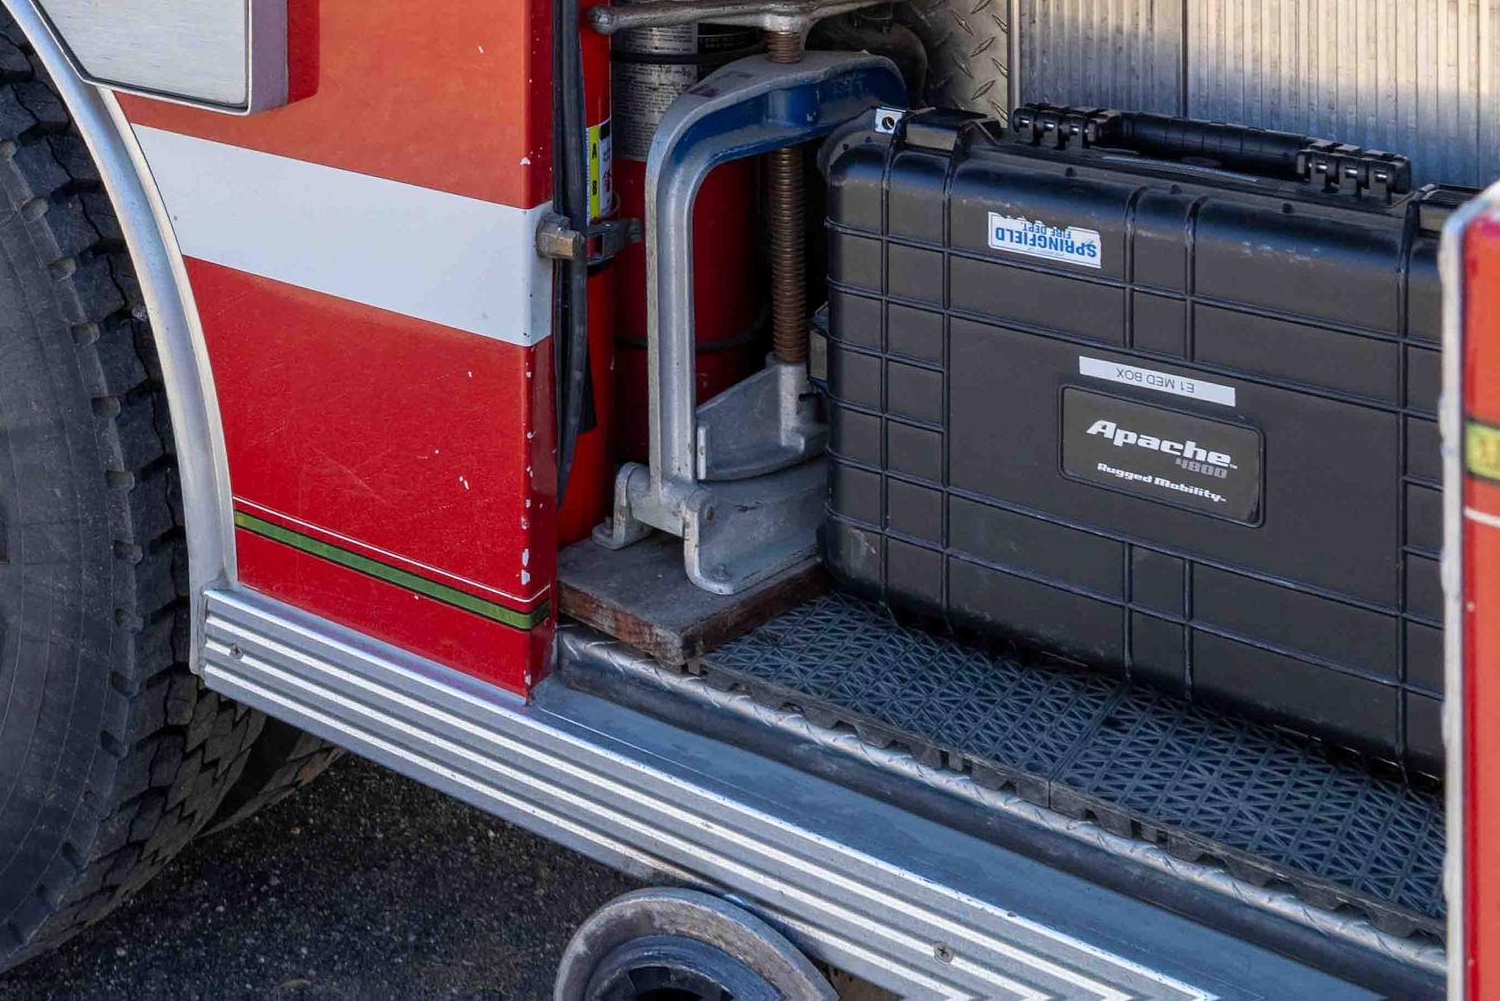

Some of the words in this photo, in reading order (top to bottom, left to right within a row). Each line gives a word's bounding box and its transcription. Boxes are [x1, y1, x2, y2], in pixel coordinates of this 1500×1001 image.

[591, 143, 598, 159] A
[995, 227, 1097, 257] SPRINGFIELD
[1116, 367, 1143, 382] BOX
[1146, 374, 1175, 389] MED
[1086, 419, 1231, 468] Apache
[1175, 457, 1228, 479] 4800
[1097, 462, 1152, 484] Rugged
[1154, 477, 1221, 502] Mobility
